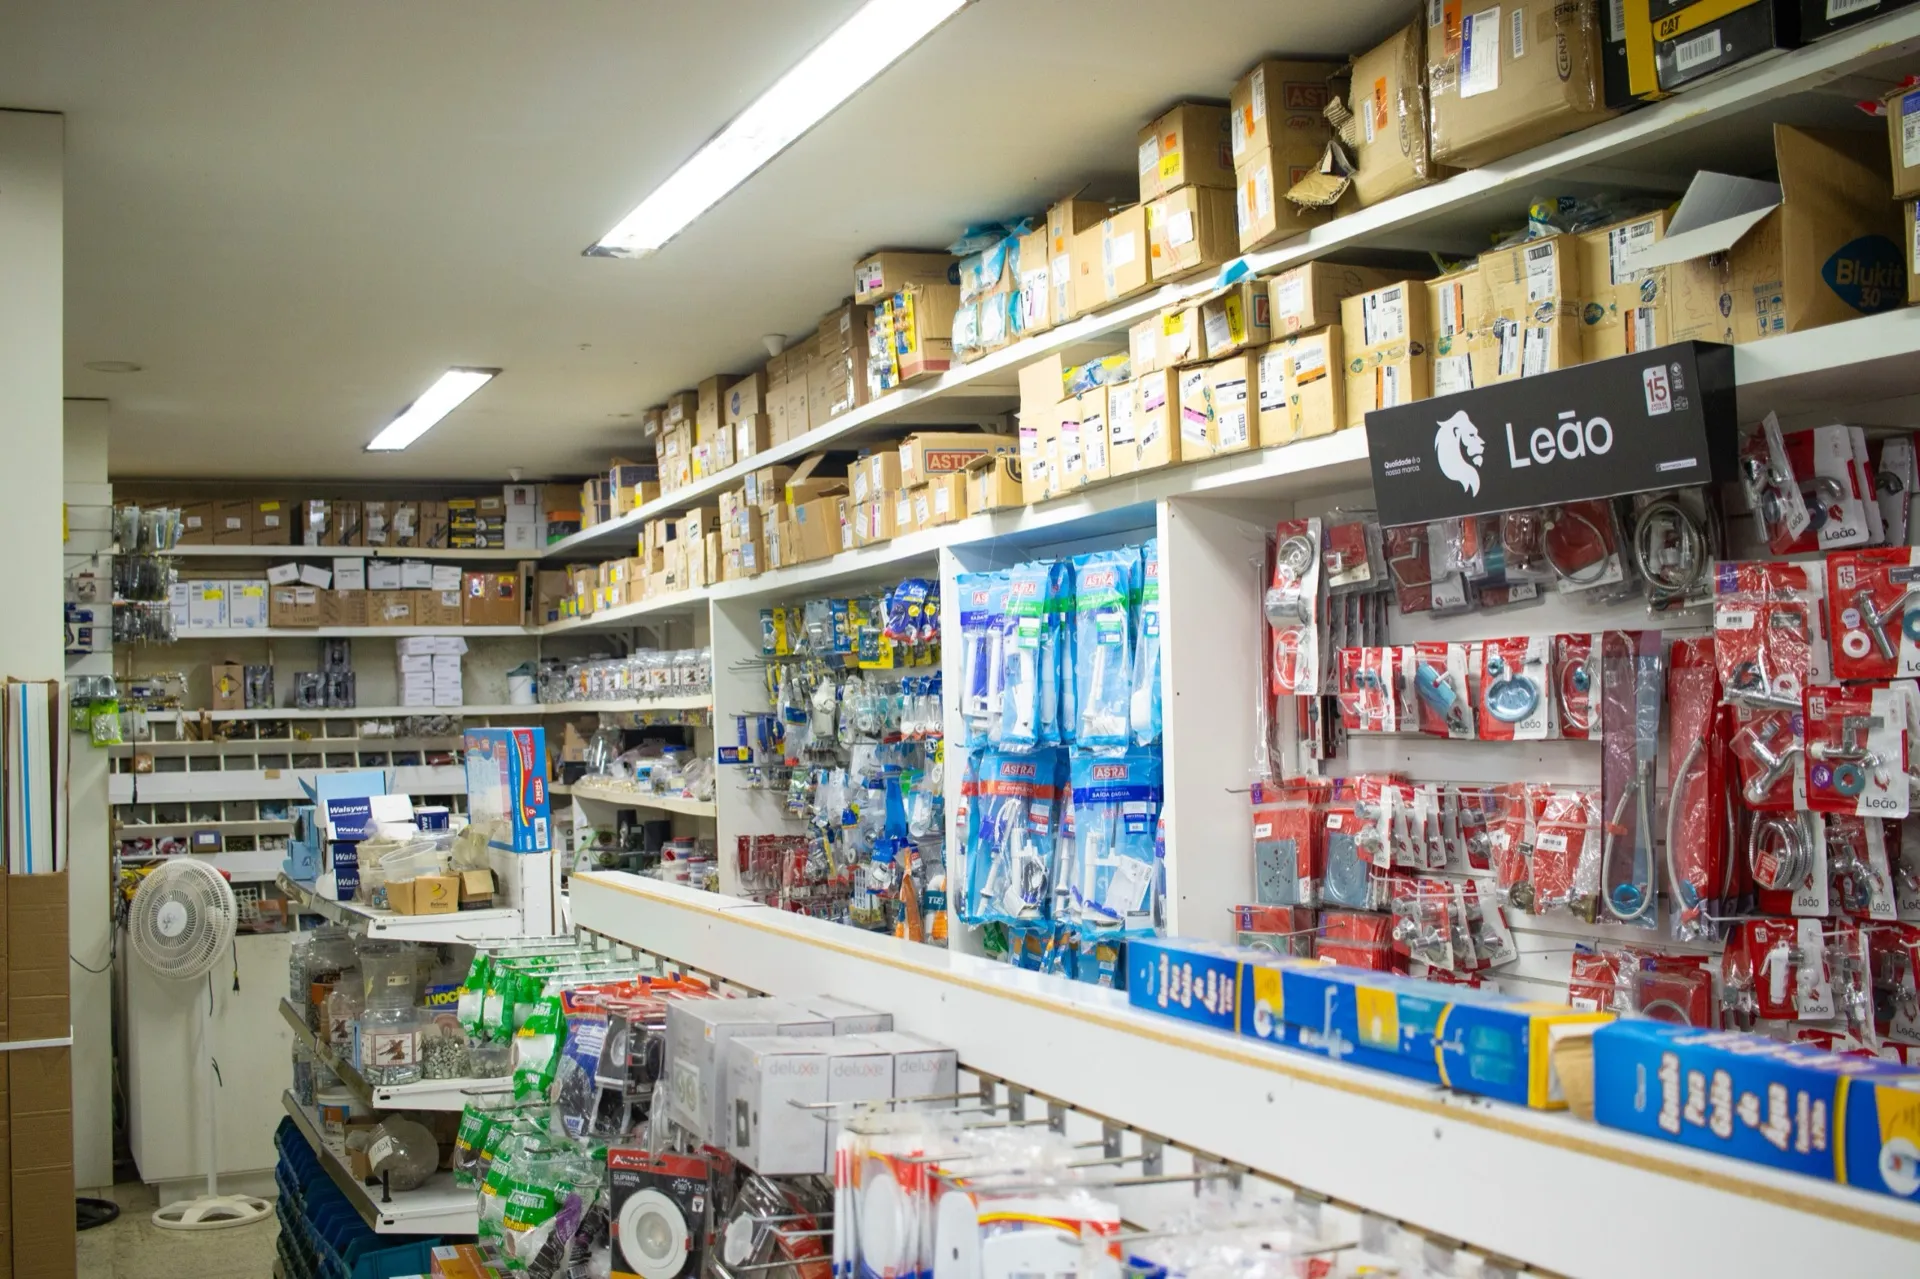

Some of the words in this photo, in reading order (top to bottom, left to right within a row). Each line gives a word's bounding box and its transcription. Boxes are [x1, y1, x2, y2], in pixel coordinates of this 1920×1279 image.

[1661, 15, 1681, 37] CAT
[1556, 33, 1572, 82] CENSI
[1289, 85, 1328, 107] AST
[1836, 258, 1905, 287] Blukit
[1859, 287, 1881, 307] 30
[1646, 376, 1667, 402] 15
[1505, 410, 1613, 469] Leão
[1384, 457, 1411, 469] Qualidade
[1825, 527, 1857, 541] Leão
[1840, 571, 1854, 584] 15
[1907, 660, 1920, 672] Le
[1811, 702, 1824, 714] 15
[1519, 719, 1541, 729] Leão
[1003, 764, 1035, 775] ASTRA
[329, 805, 369, 814] Walsywa
[1866, 796, 1898, 810] Leão
[335, 852, 357, 862] Wals
[337, 877, 360, 886] Wals
[1798, 895, 1820, 908] Leão
[1872, 898, 1891, 912] Leão
[1756, 930, 1766, 941] 15
[1803, 1002, 1829, 1013] Leão
[769, 1058, 820, 1077] deluxe
[834, 1060, 884, 1078] deluxe
[900, 1057, 948, 1074] deluxe
[1658, 1051, 1681, 1135] Bomba
[1683, 1069, 1706, 1127] Para
[1736, 1091, 1760, 1128] de
[613, 1173, 640, 1183] SUPIMPA
